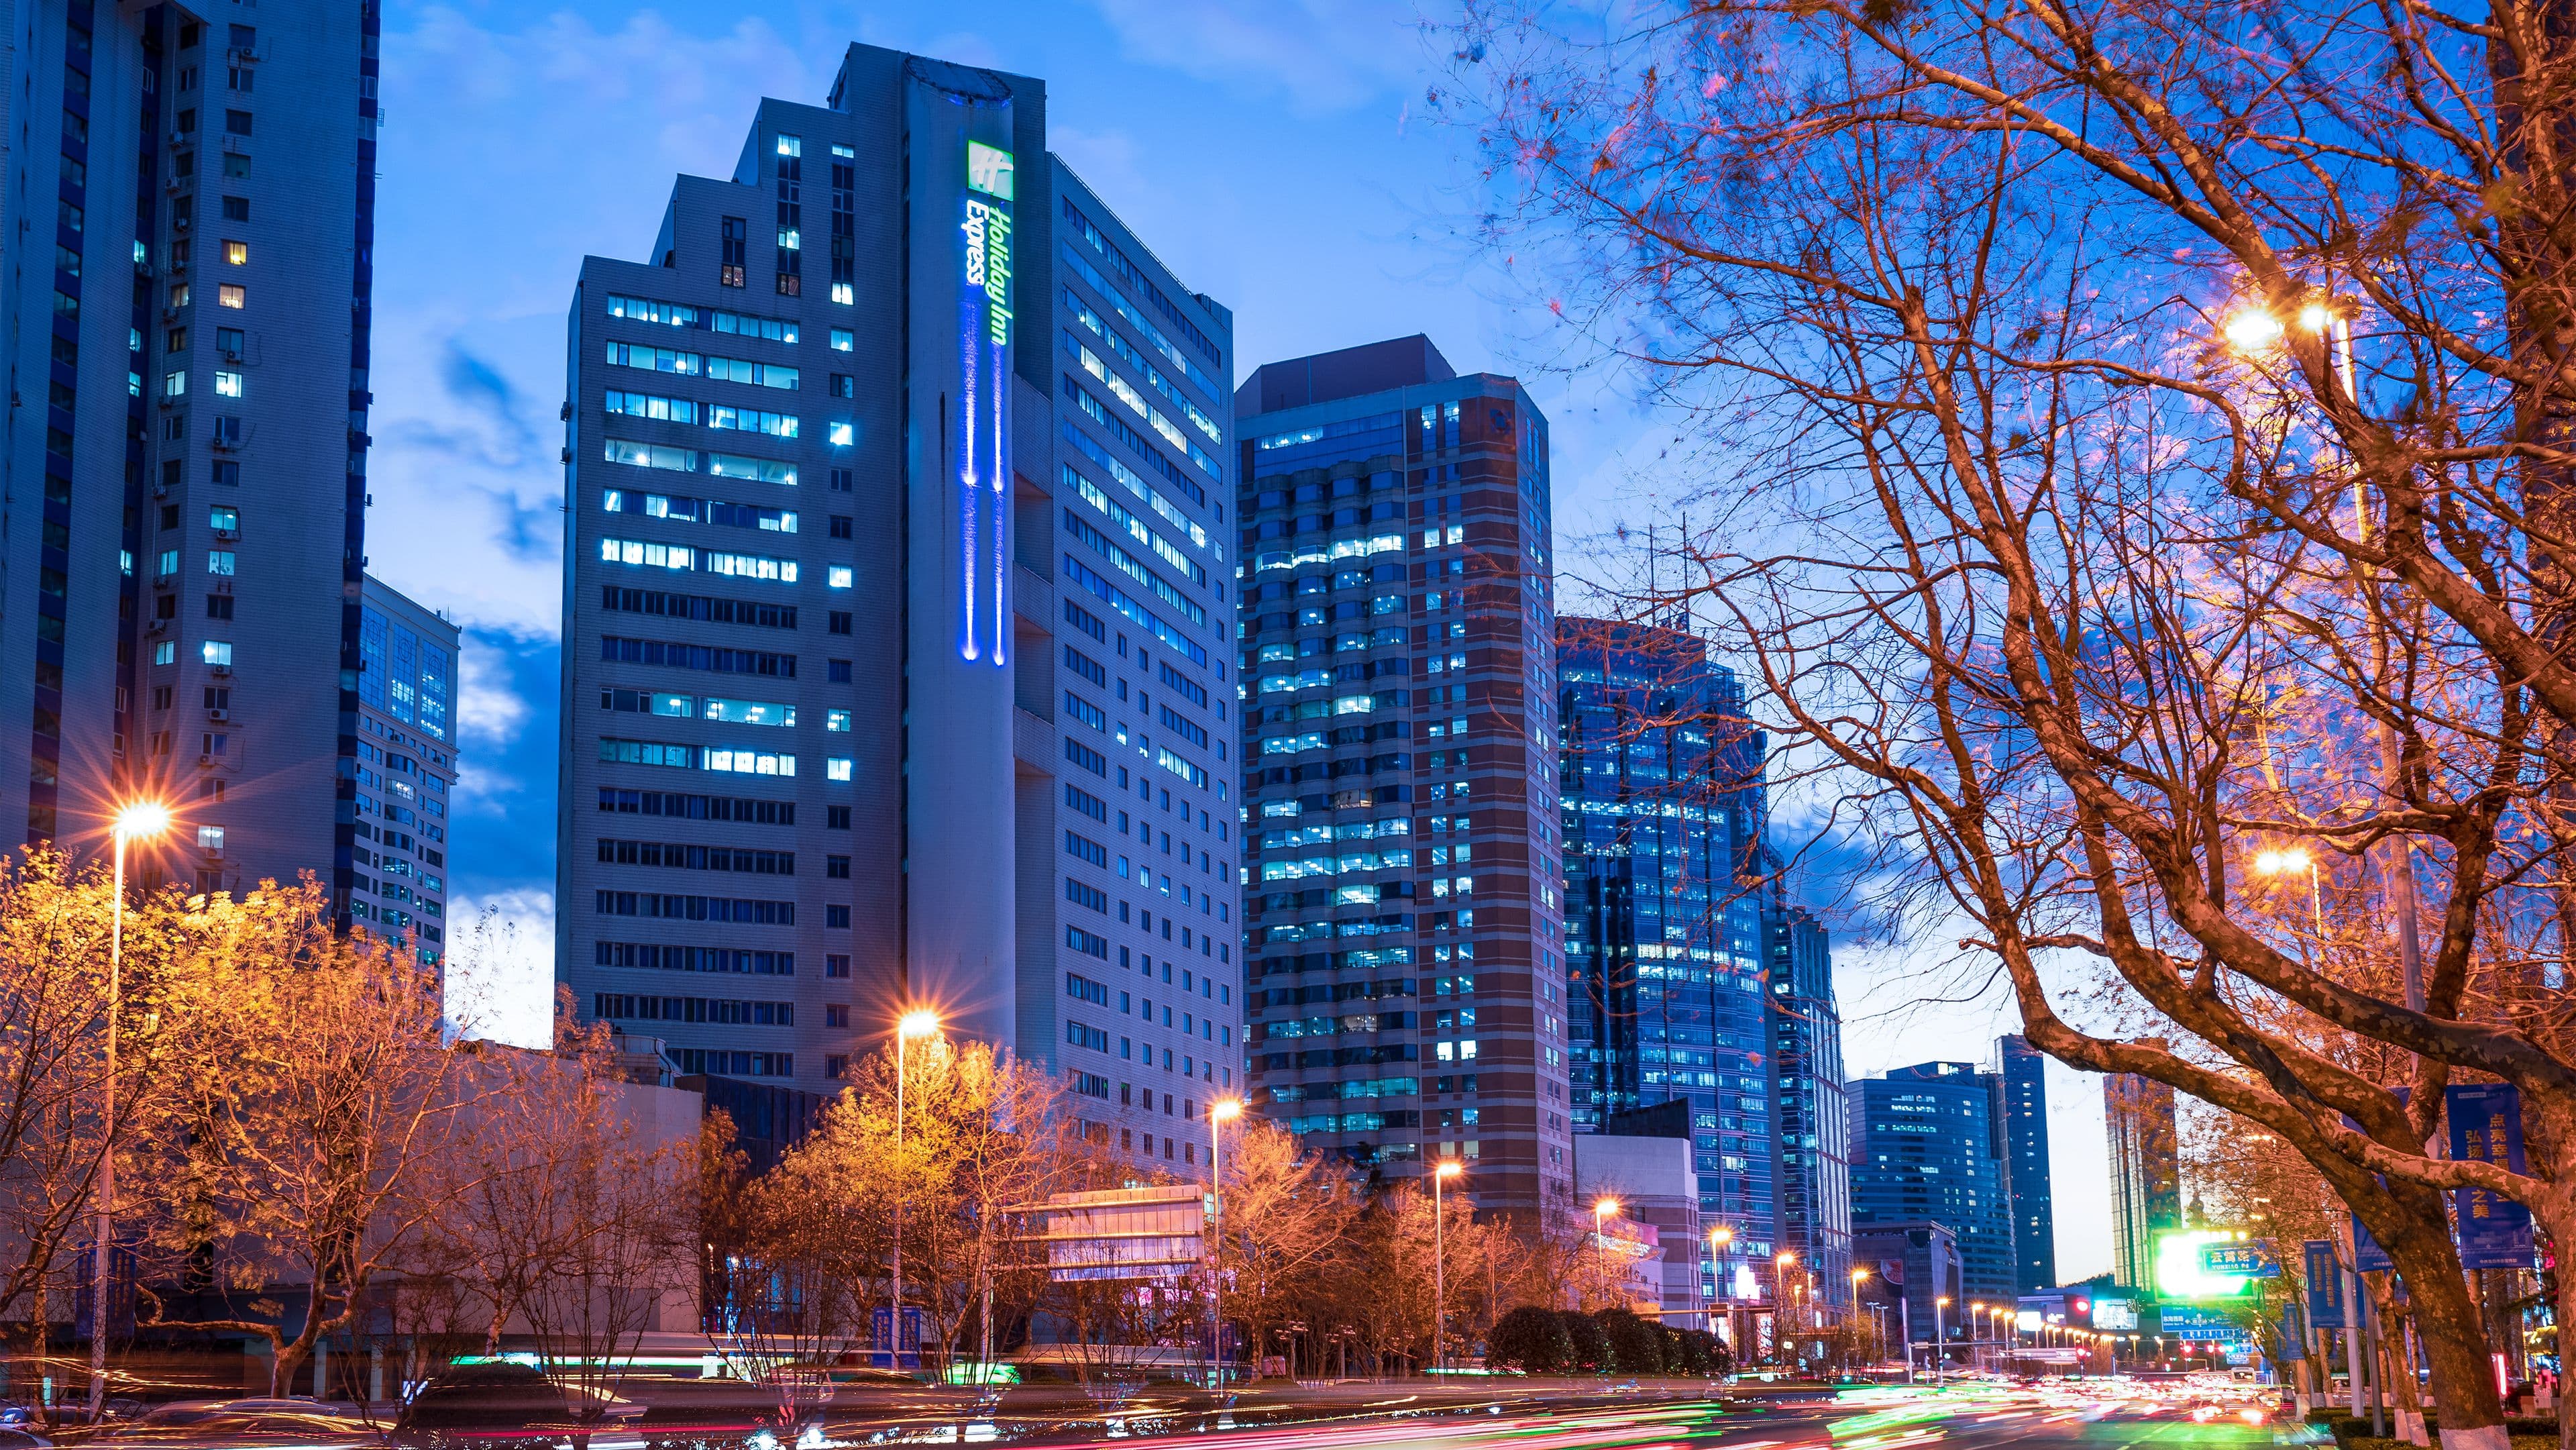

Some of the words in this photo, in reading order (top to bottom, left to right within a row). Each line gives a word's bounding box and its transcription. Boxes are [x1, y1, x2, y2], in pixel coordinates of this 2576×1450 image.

[961, 199, 989, 286] Express
[985, 206, 1011, 306] Holiday
[991, 307, 1013, 346] Inn
[2465, 1129, 2490, 1219] 弘扬之美
